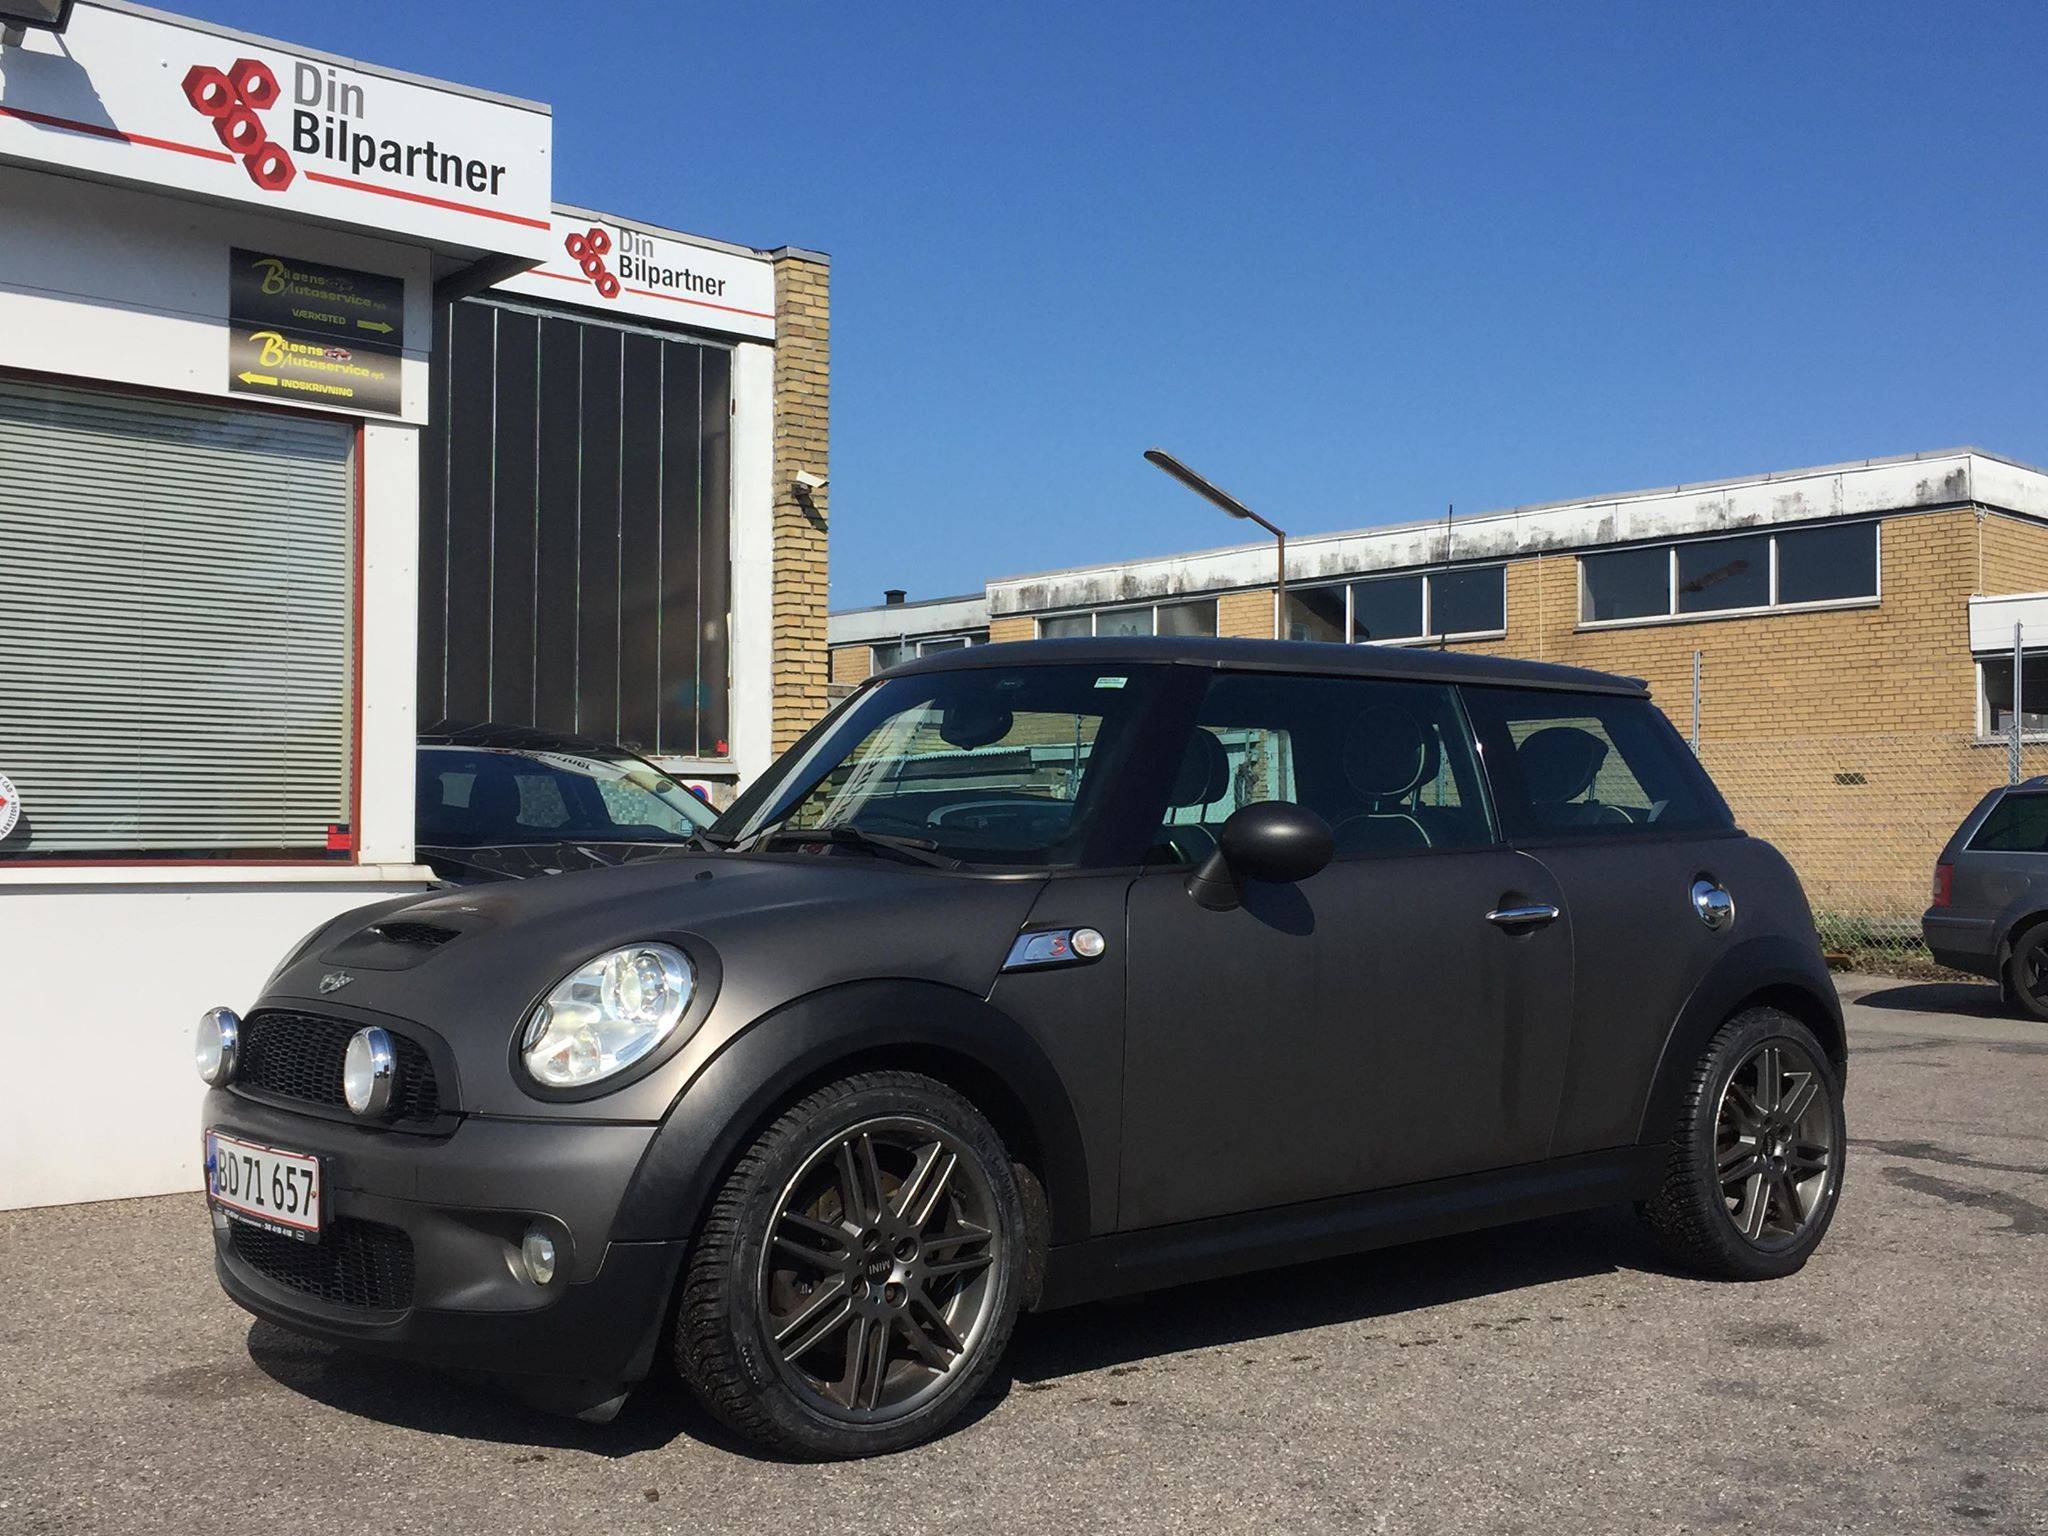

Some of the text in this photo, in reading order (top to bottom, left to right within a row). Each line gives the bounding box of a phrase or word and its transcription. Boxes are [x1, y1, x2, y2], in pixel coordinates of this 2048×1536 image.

[294, 61, 364, 119] Din
[293, 109, 506, 195] Bilpartner
[619, 229, 654, 258] Din
[619, 255, 726, 296] Bilpartner
[292, 308, 347, 325] VÆRKSTED
[281, 379, 354, 397] INDSKRIVNING
[272, 1162, 314, 1216] 657
